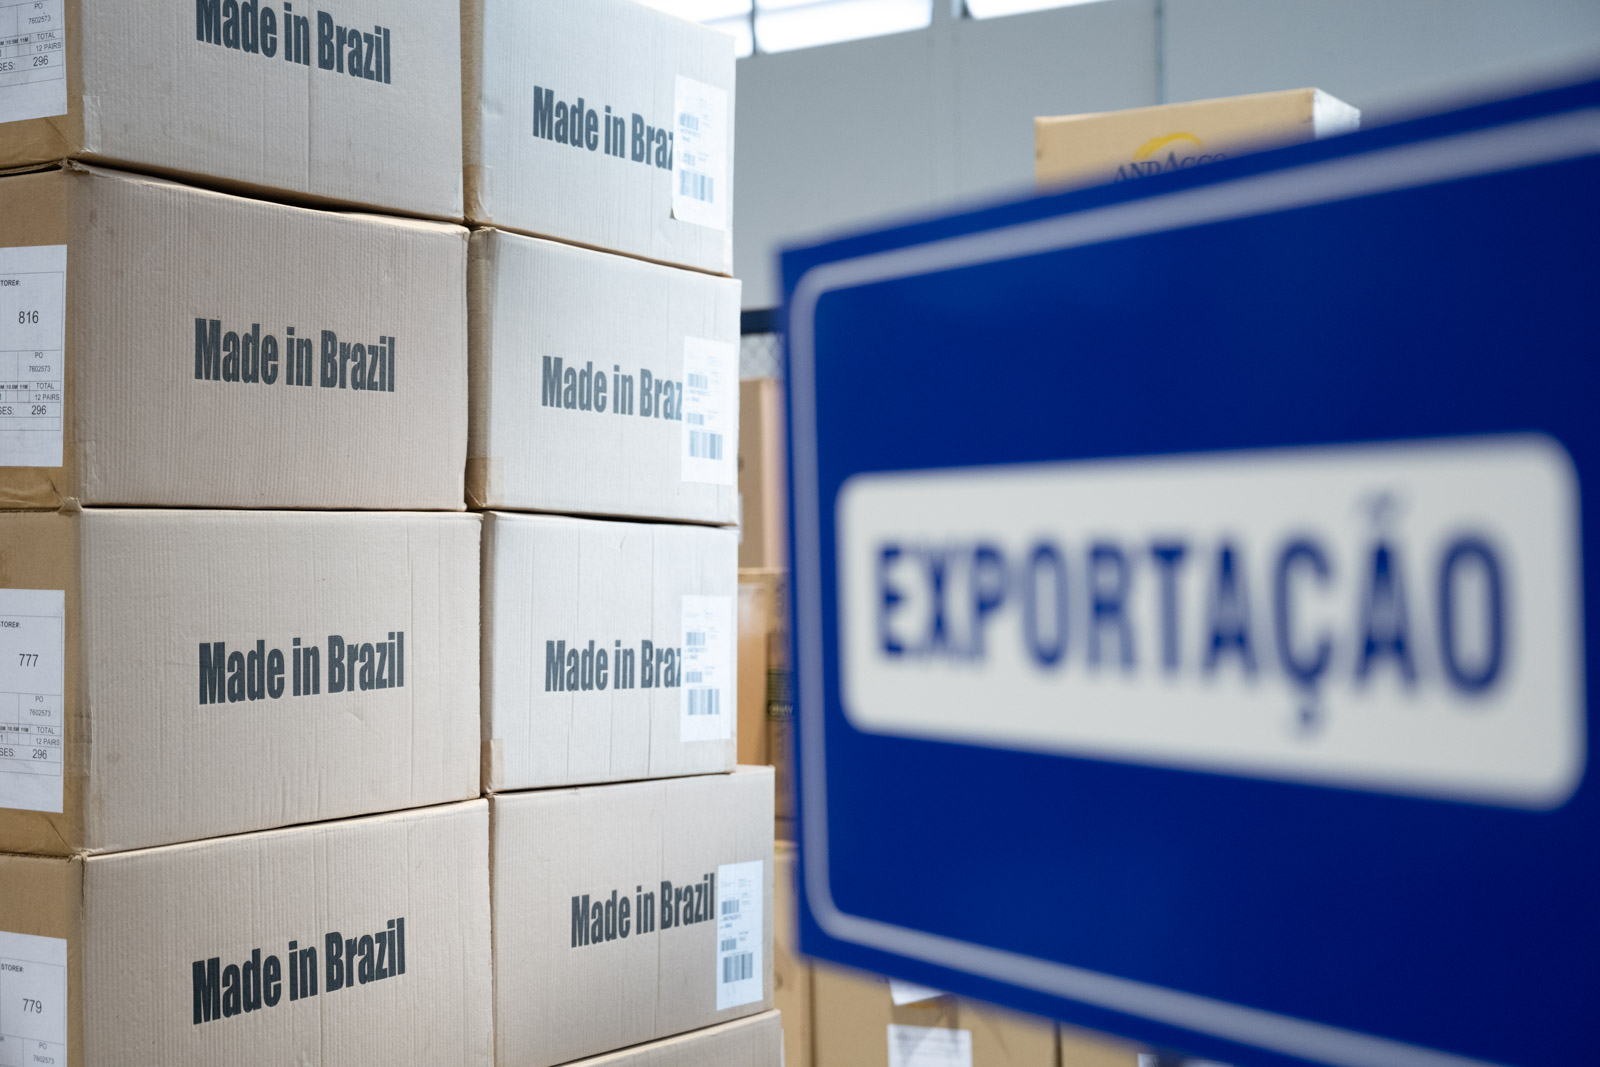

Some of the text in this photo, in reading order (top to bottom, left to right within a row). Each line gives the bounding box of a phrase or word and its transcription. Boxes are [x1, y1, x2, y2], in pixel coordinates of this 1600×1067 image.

[34, 2, 43, 10] PO
[37, 32, 55, 40] TOTAL
[196, 0, 391, 84] Made in Brazil
[43, 41, 62, 50] PAIRS
[33, 55, 49, 67] 296
[533, 85, 674, 171] Made in Braz
[18, 310, 39, 324] 816
[34, 351, 44, 359] PO
[195, 317, 396, 393] Made in Brazil
[28, 365, 51, 373] 7602573
[36, 382, 55, 390] TOTAL
[542, 356, 683, 422] Made in Braz
[34, 393, 60, 401] 12 PAIRS
[31, 404, 47, 415] 296
[872, 488, 1514, 738] EXPORTAÇÃO
[19, 653, 39, 668] 777
[545, 639, 682, 692] Made in Braz
[199, 631, 404, 705] Made in Brazil
[35, 695, 44, 703] PO
[37, 726, 55, 735] TOTAL
[36, 737, 61, 746] 12 PAIRS
[32, 748, 48, 760] 296
[571, 872, 715, 949] Made in Brazil
[1, 963, 25, 973] STORE#:
[192, 917, 406, 1026] Made in Brazil
[23, 998, 43, 1014] 779
[38, 1041, 48, 1050] PO
